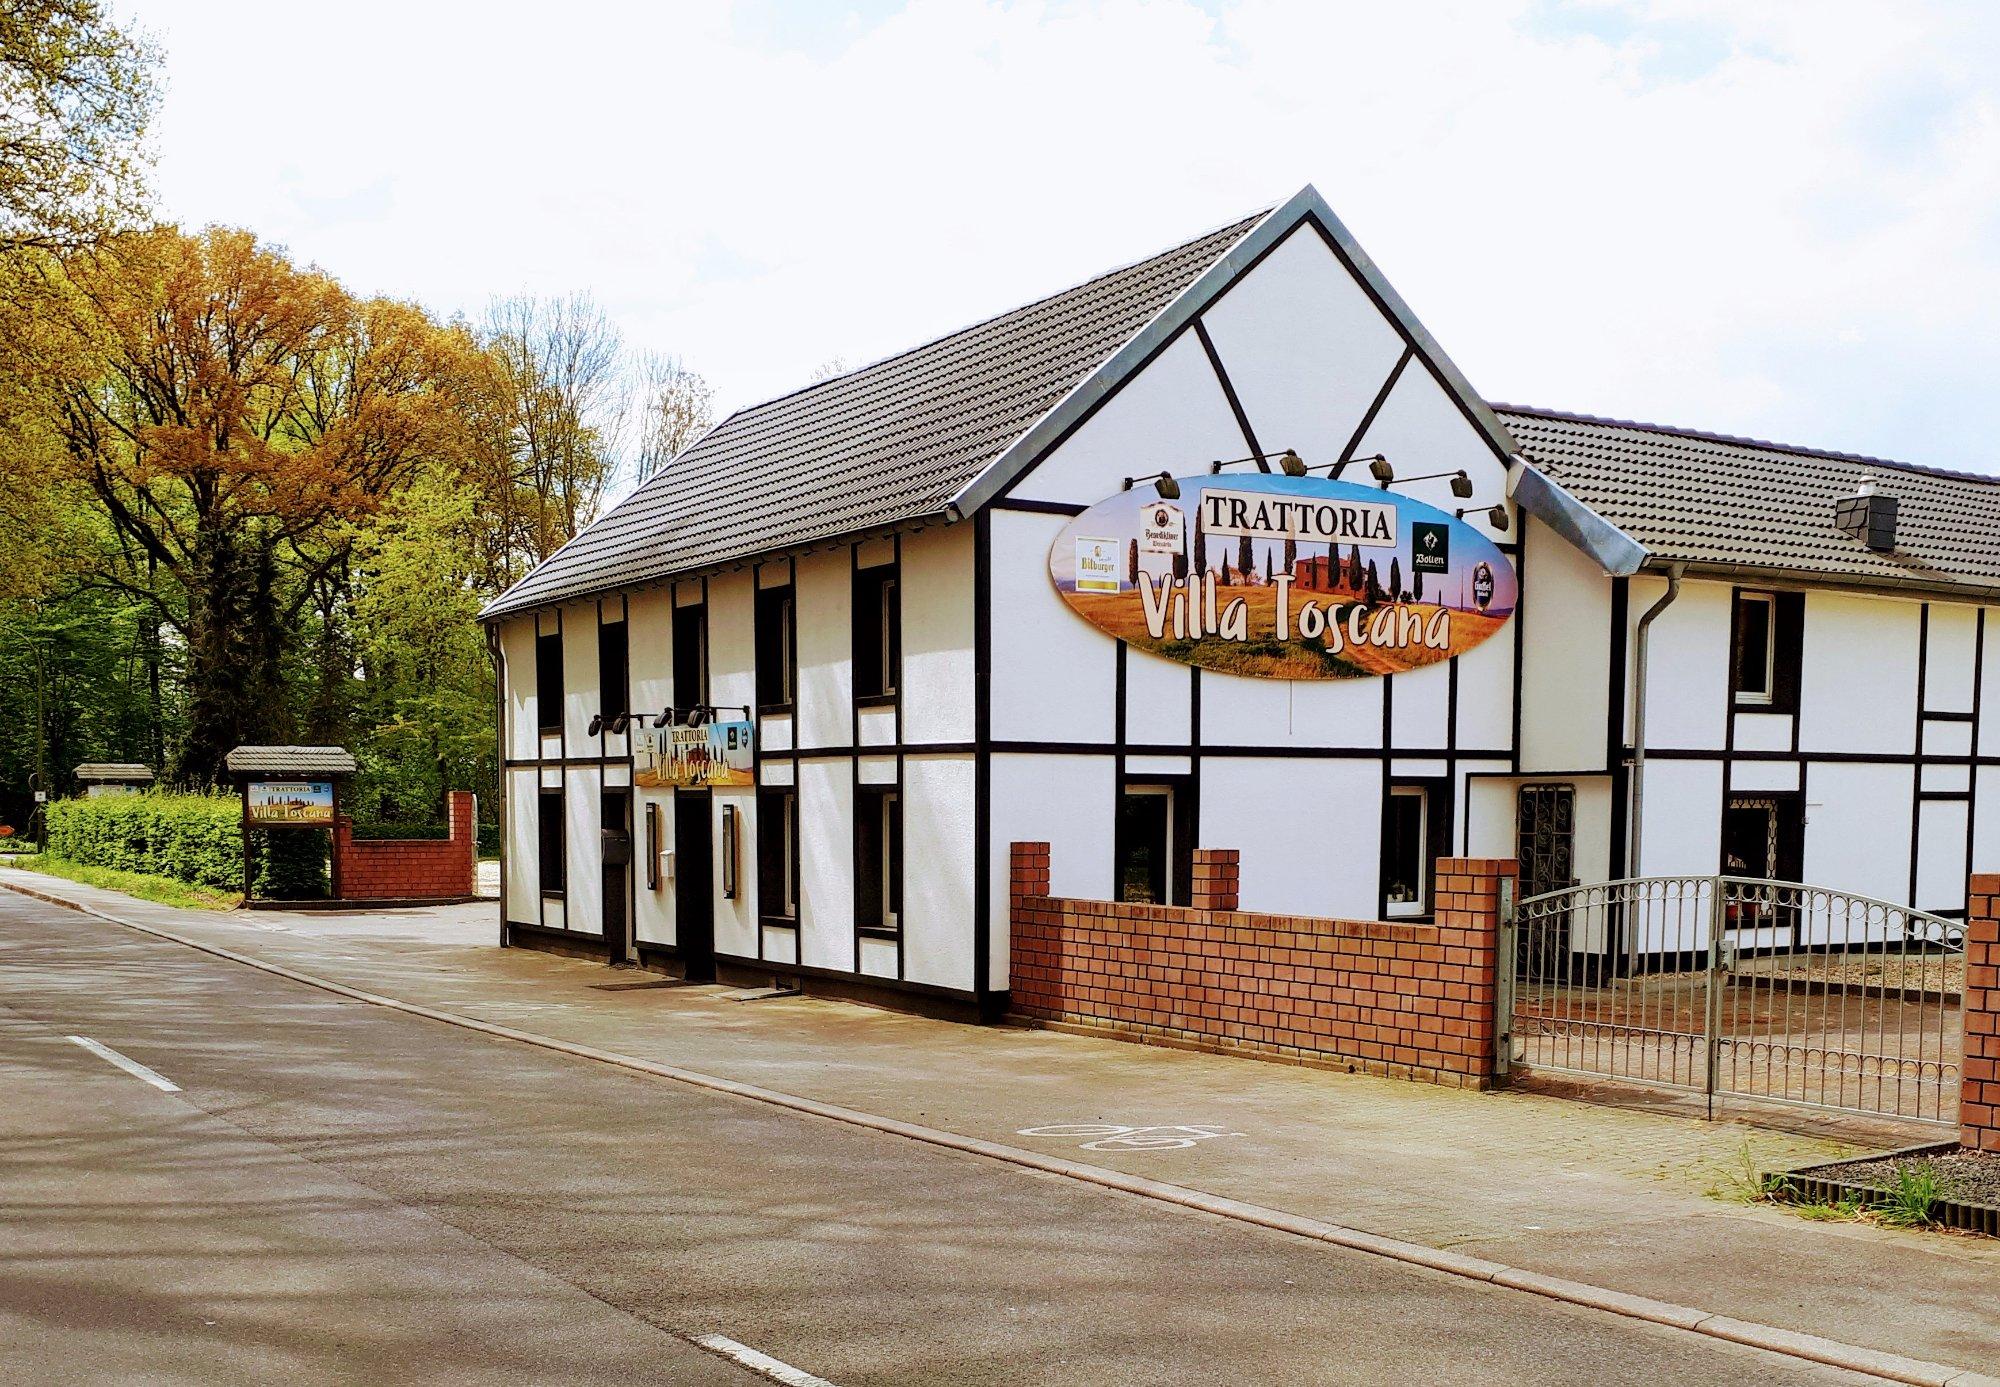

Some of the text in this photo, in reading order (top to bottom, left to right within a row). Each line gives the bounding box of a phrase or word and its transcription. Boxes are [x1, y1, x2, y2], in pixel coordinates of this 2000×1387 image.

[1205, 494, 1392, 541] TRATTORIA
[1081, 556, 1115, 573] Bitburger
[1137, 570, 1450, 654] Villa Toscana
[671, 729, 708, 743] TRATTORIA
[655, 749, 729, 784] Villa Toscana
[252, 804, 331, 819] Villa Toscana
